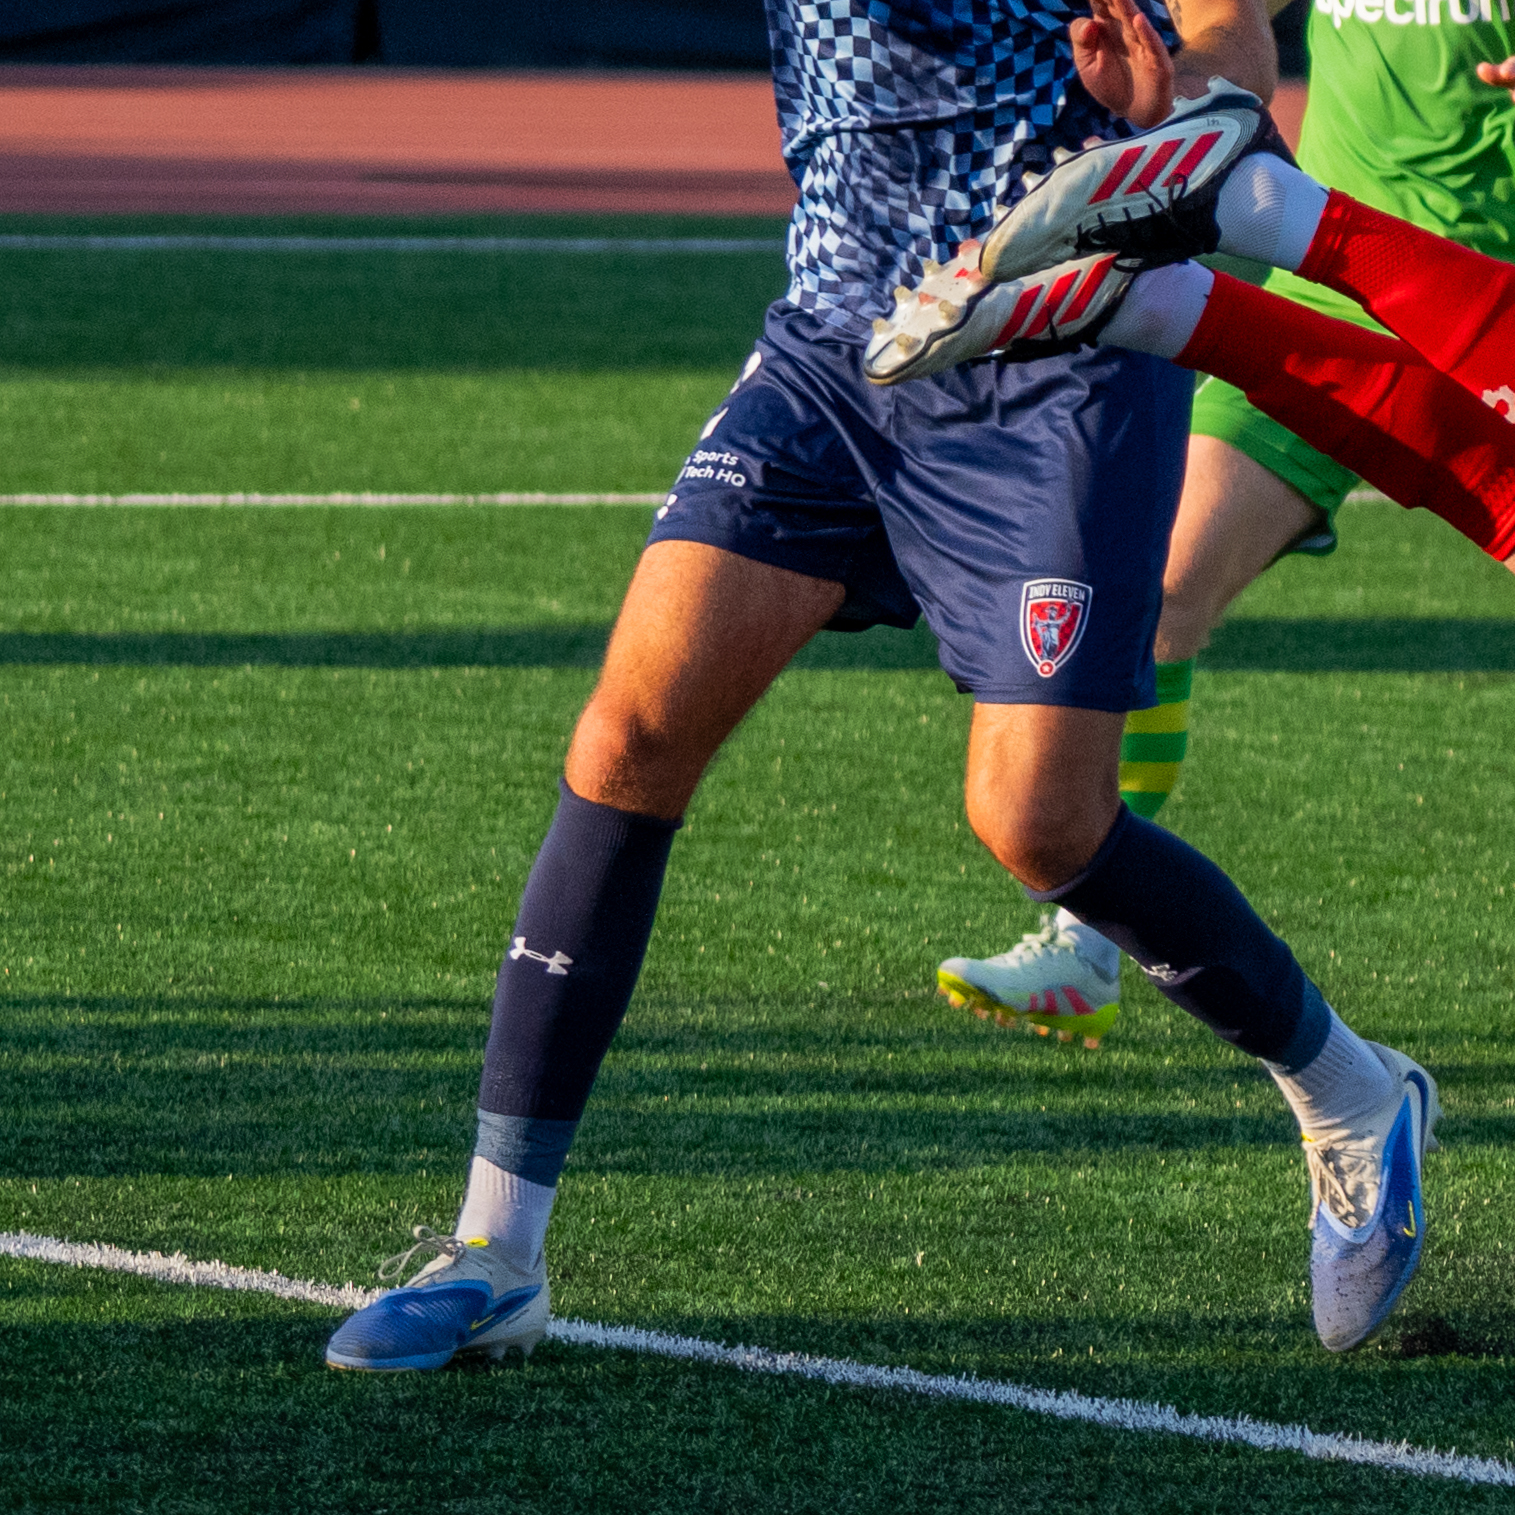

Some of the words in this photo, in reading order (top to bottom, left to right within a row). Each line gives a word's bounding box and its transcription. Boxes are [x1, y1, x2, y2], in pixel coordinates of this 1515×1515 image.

[692, 450, 739, 466] Sports
[685, 465, 715, 479] Tech
[715, 468, 747, 488] HQ
[1029, 584, 1052, 599] INDY
[1051, 583, 1086, 602] ELEVEN
